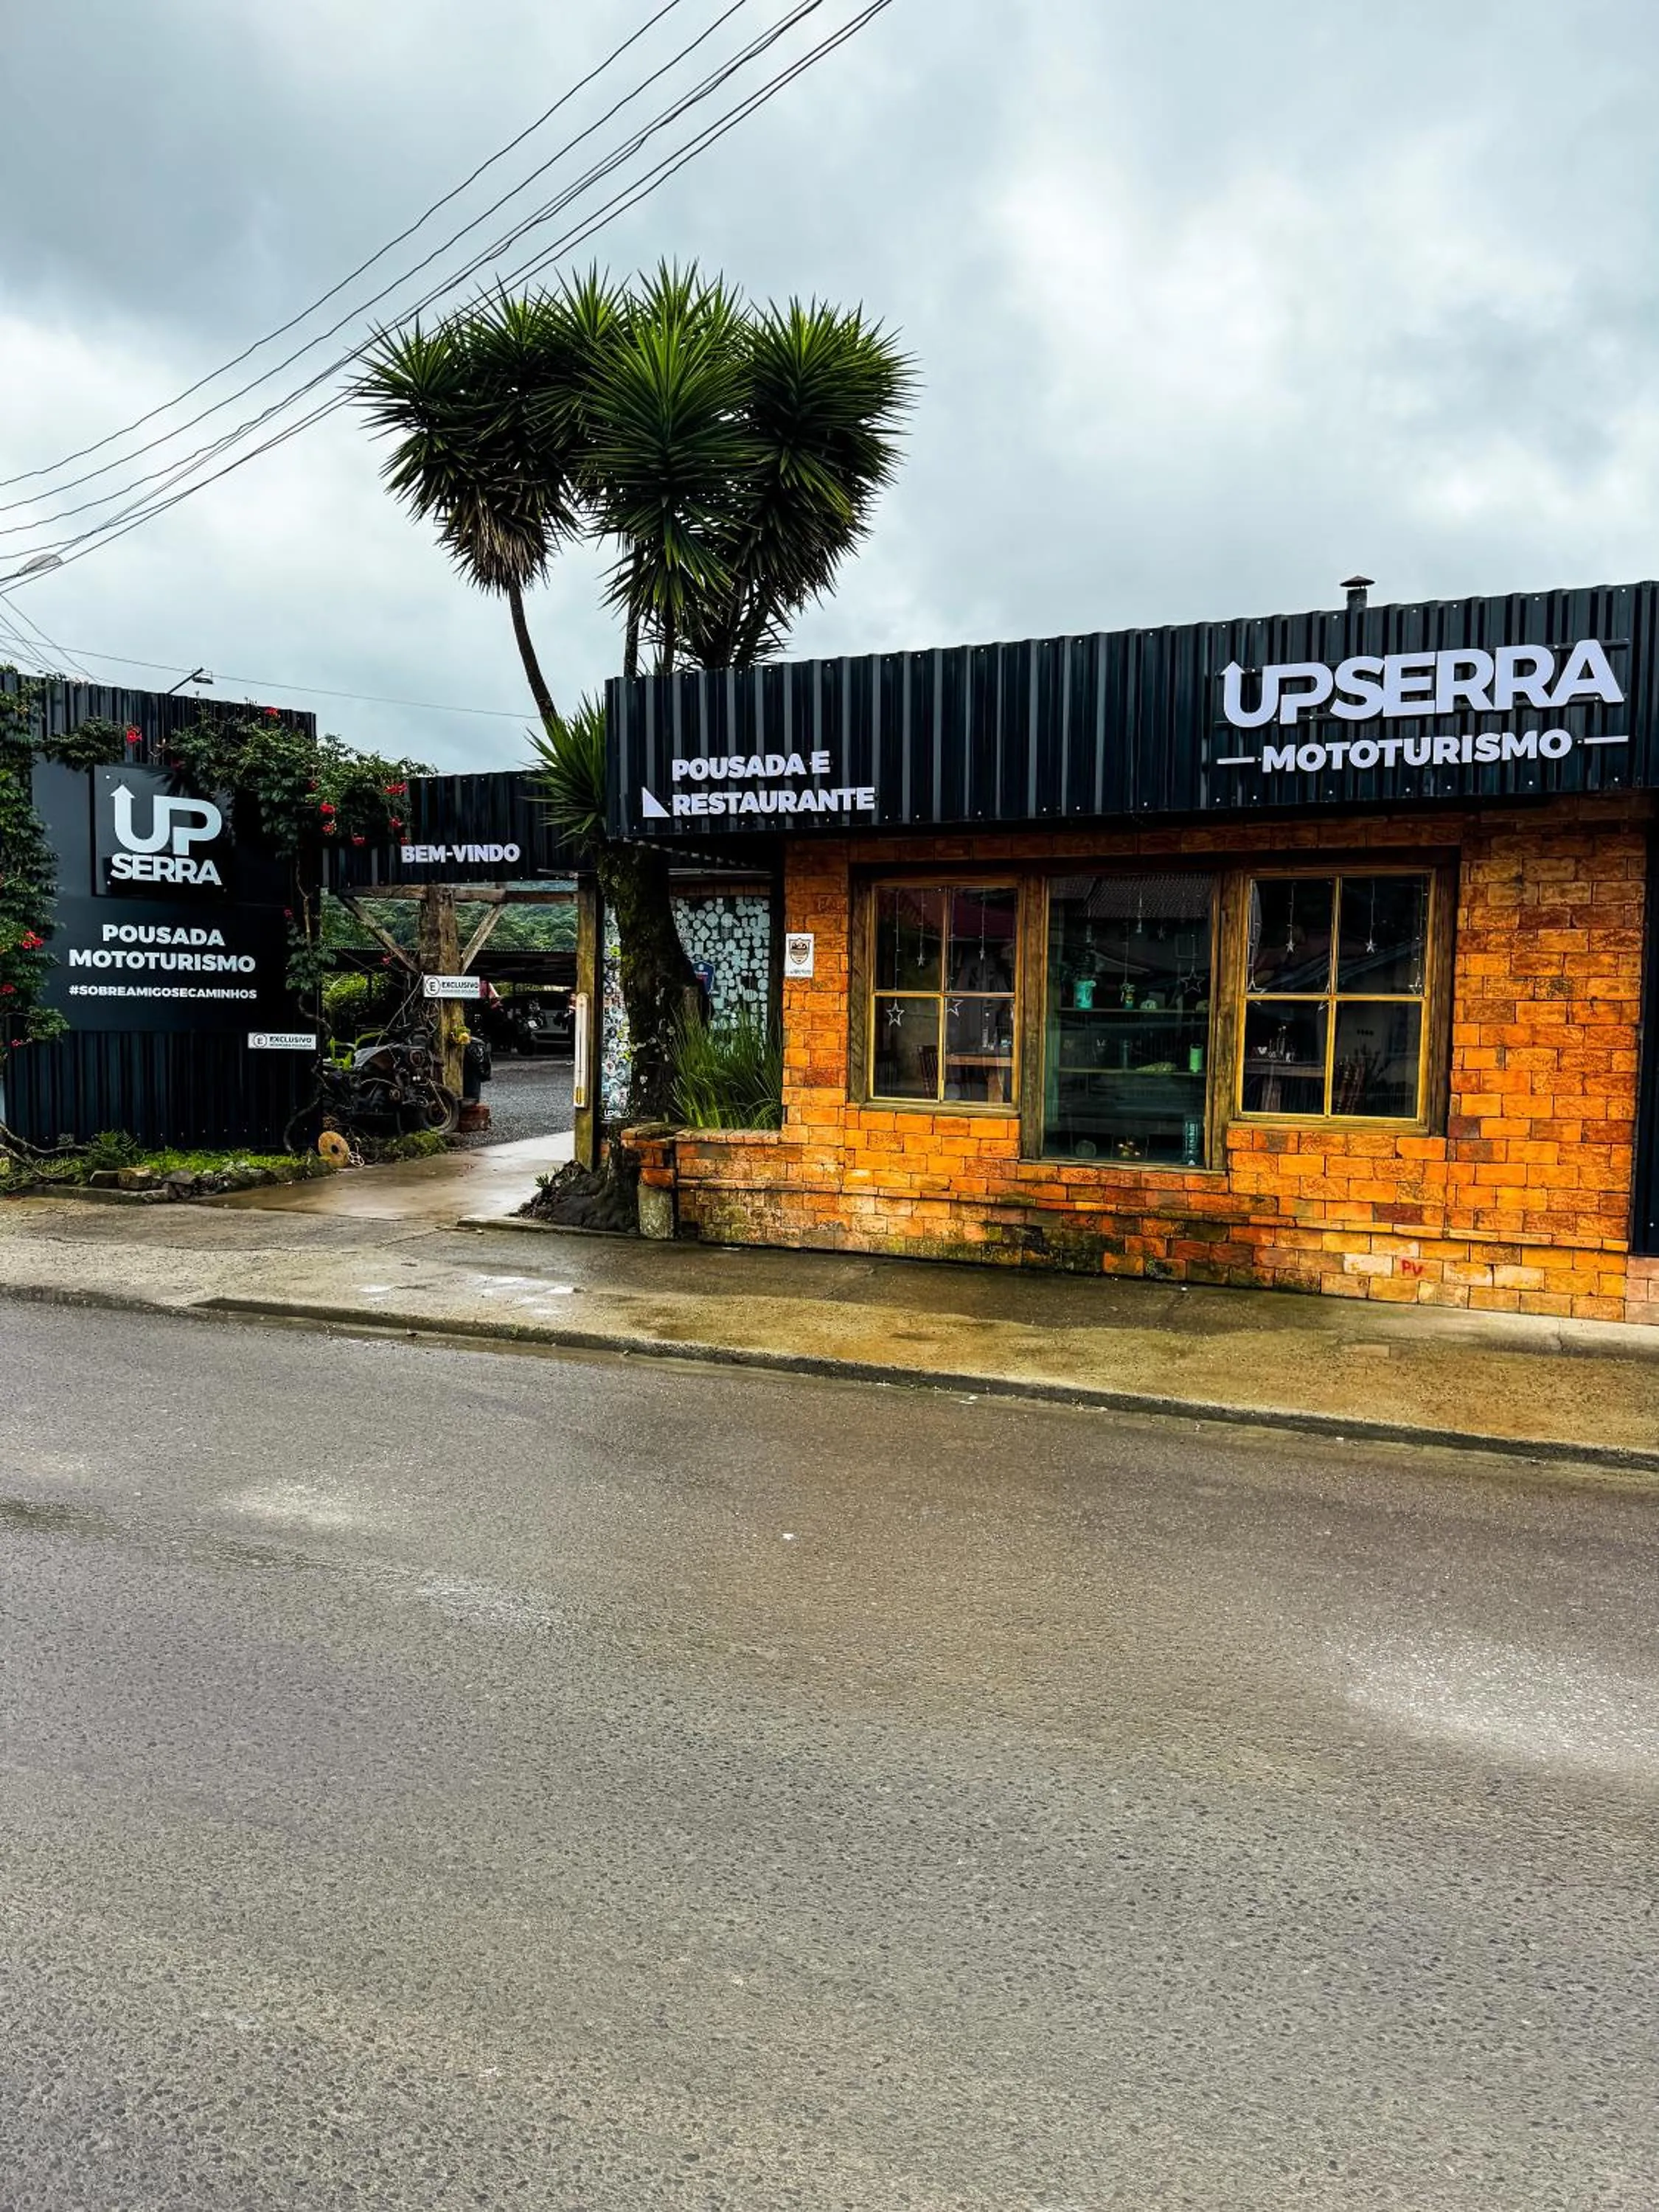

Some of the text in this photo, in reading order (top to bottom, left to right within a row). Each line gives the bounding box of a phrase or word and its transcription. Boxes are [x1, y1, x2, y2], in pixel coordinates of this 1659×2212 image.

[1262, 728, 1573, 773] MOTOTURISMO
[672, 750, 831, 782] POUSADA E
[672, 786, 876, 816] RESTAURANTE
[110, 784, 223, 855] UP
[400, 842, 521, 863] BEM-VINDO
[110, 852, 223, 886] SERRA
[102, 923, 226, 947] POUSADA
[69, 949, 257, 973] MOTOTURISMO
[69, 984, 258, 999] #SOBREAMIGOSECAMINHOS
